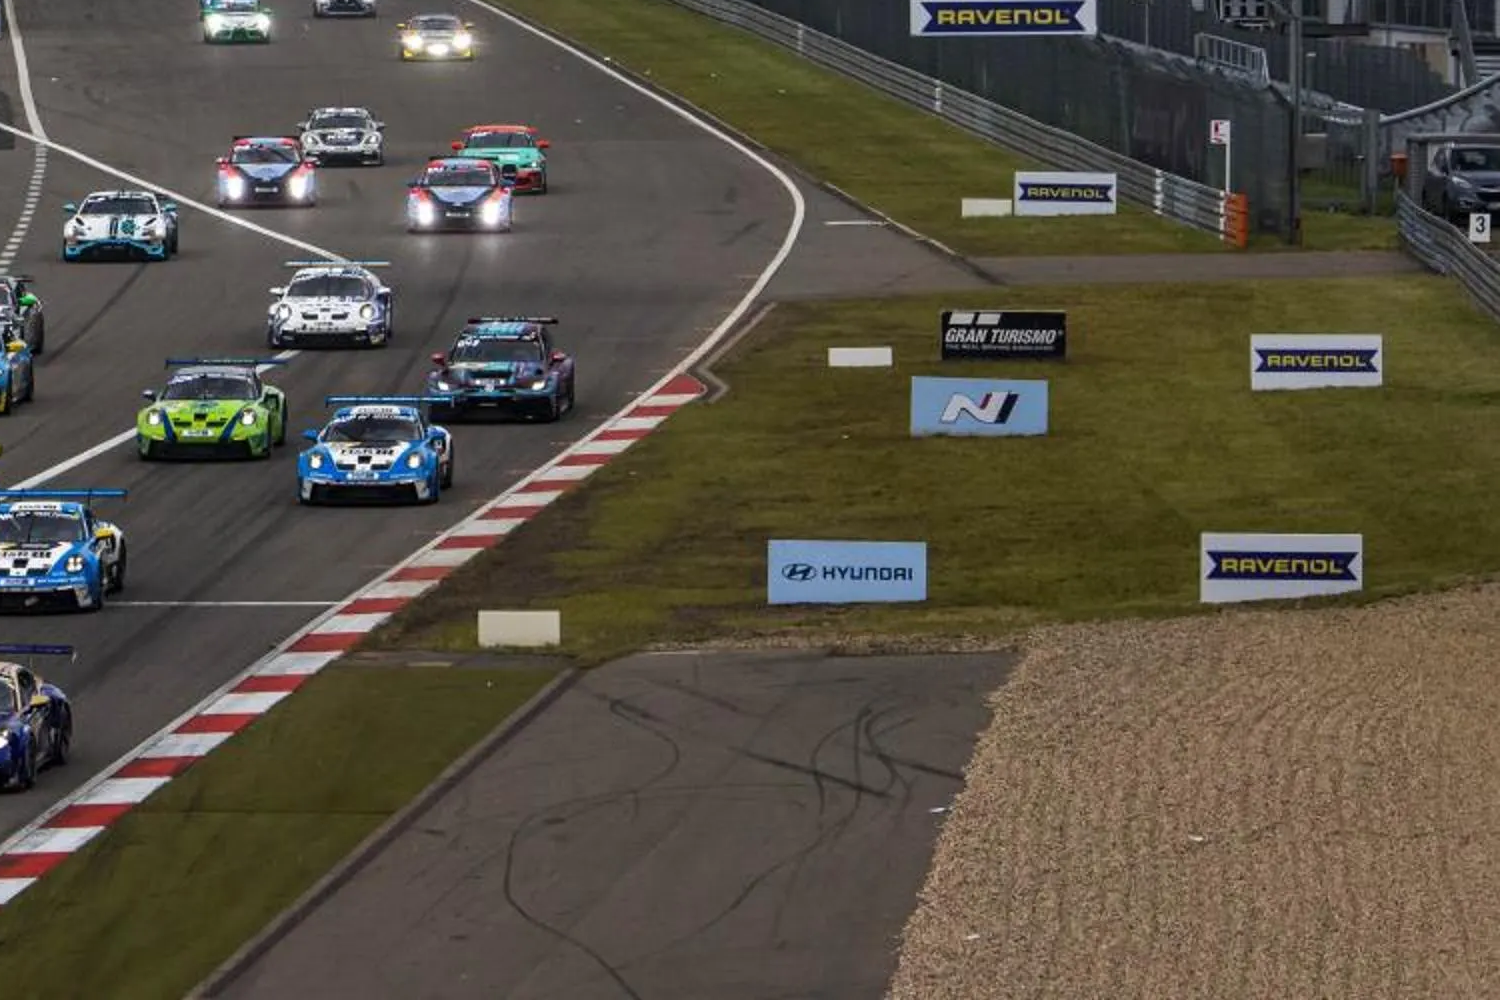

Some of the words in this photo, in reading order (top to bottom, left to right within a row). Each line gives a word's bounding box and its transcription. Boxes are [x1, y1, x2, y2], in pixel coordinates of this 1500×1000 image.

[936, 8, 1071, 26] RAVENOL
[1027, 187, 1105, 199] RAVENOL
[1475, 215, 1486, 234] 3
[945, 328, 988, 343] GRAN
[991, 329, 1057, 344] TURISMO
[1267, 355, 1367, 368] RAVENOL
[1221, 557, 1344, 574] RAVENOL
[823, 566, 913, 582] HYUNDAI
